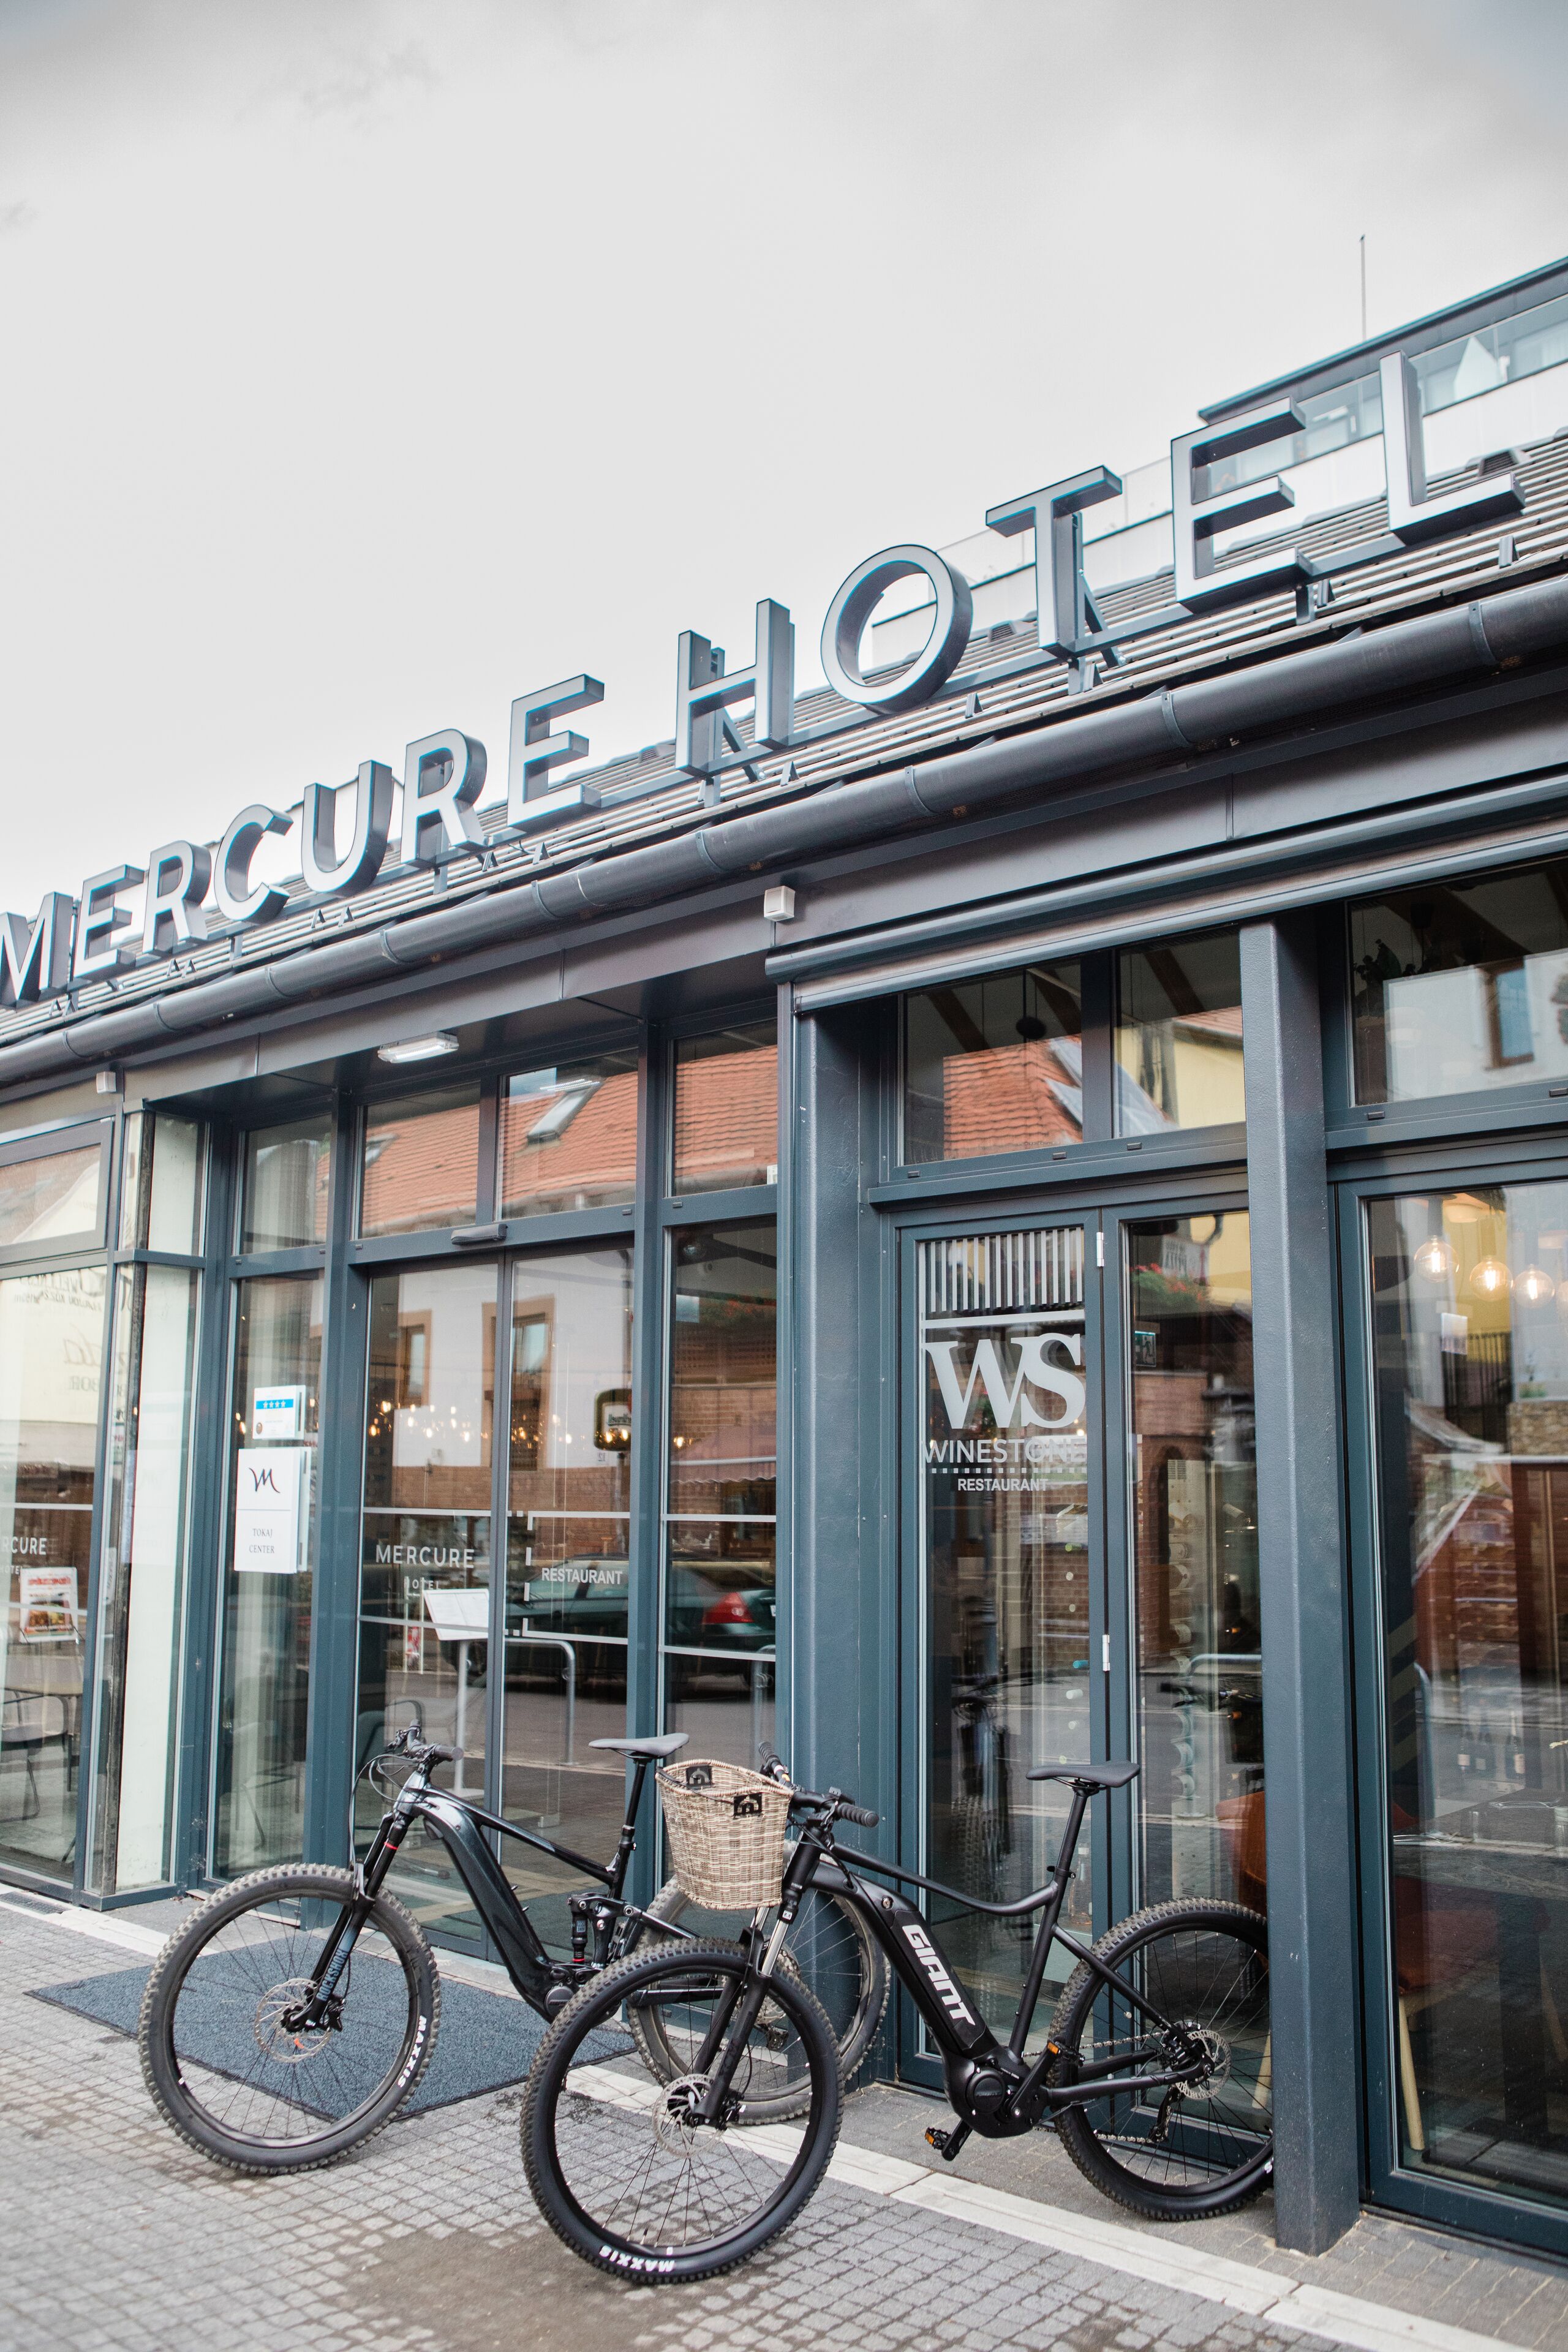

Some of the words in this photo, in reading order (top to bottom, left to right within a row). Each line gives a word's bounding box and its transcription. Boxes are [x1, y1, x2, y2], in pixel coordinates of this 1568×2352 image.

[0, 673, 605, 1005] MERCURE
[675, 349, 1526, 778] HOTEL
[921, 1332, 1085, 1429] WS
[922, 1439, 1087, 1463] WINESTONE
[957, 1478, 1049, 1491] RESTAURANT
[252, 1528, 273, 1538] TOKAJ
[249, 1545, 275, 1553] CENTER
[375, 1544, 475, 1569] MERCURE
[541, 1567, 623, 1585] RESTAURANT
[316, 1949, 348, 2002] ROCKSHOX
[902, 1924, 975, 2026] GIANT
[398, 2015, 427, 2088] MAXXIS
[599, 2244, 675, 2273] MAXXIS
